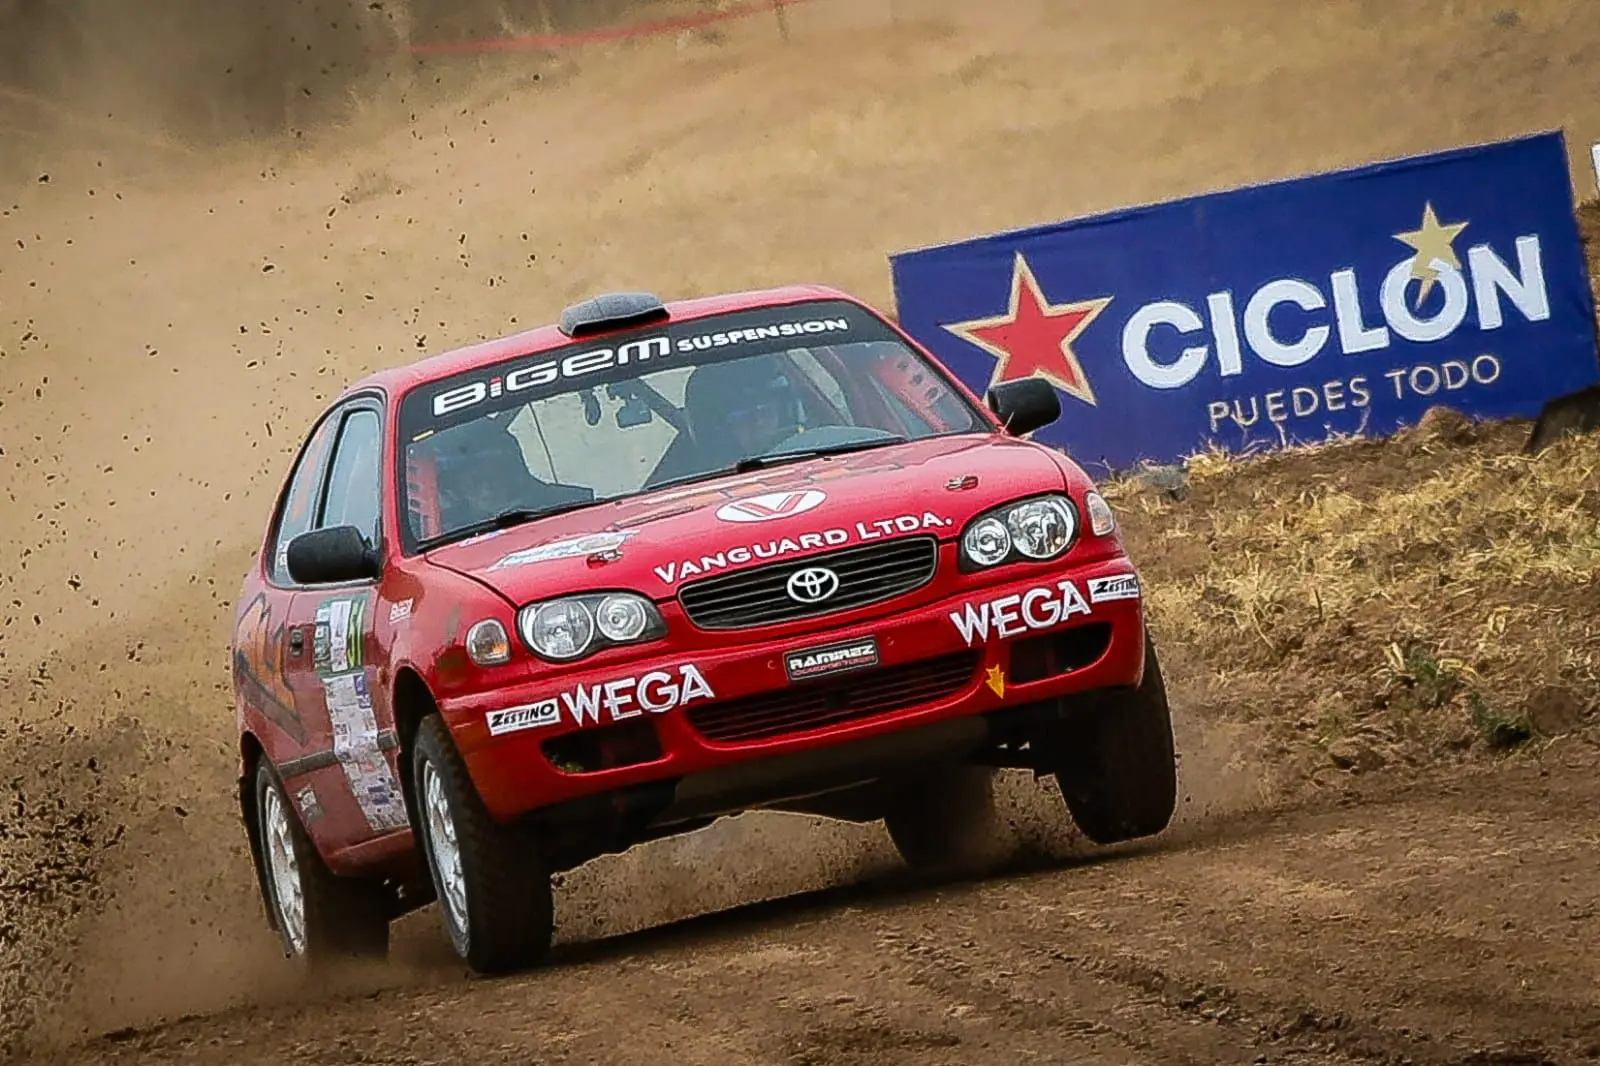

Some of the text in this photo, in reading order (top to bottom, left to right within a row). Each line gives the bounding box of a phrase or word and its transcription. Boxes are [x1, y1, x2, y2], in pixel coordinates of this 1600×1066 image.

[677, 317, 849, 353] SUSPENSION
[1208, 354, 1501, 433] PUEDES TODO
[653, 529, 848, 584] VANGUARD
[855, 511, 954, 541] LTDA.
[949, 580, 1092, 647] WEGA
[789, 644, 875, 670] RAMIREZ
[490, 702, 555, 729] ZESTINO
[560, 663, 716, 727] WEGA
